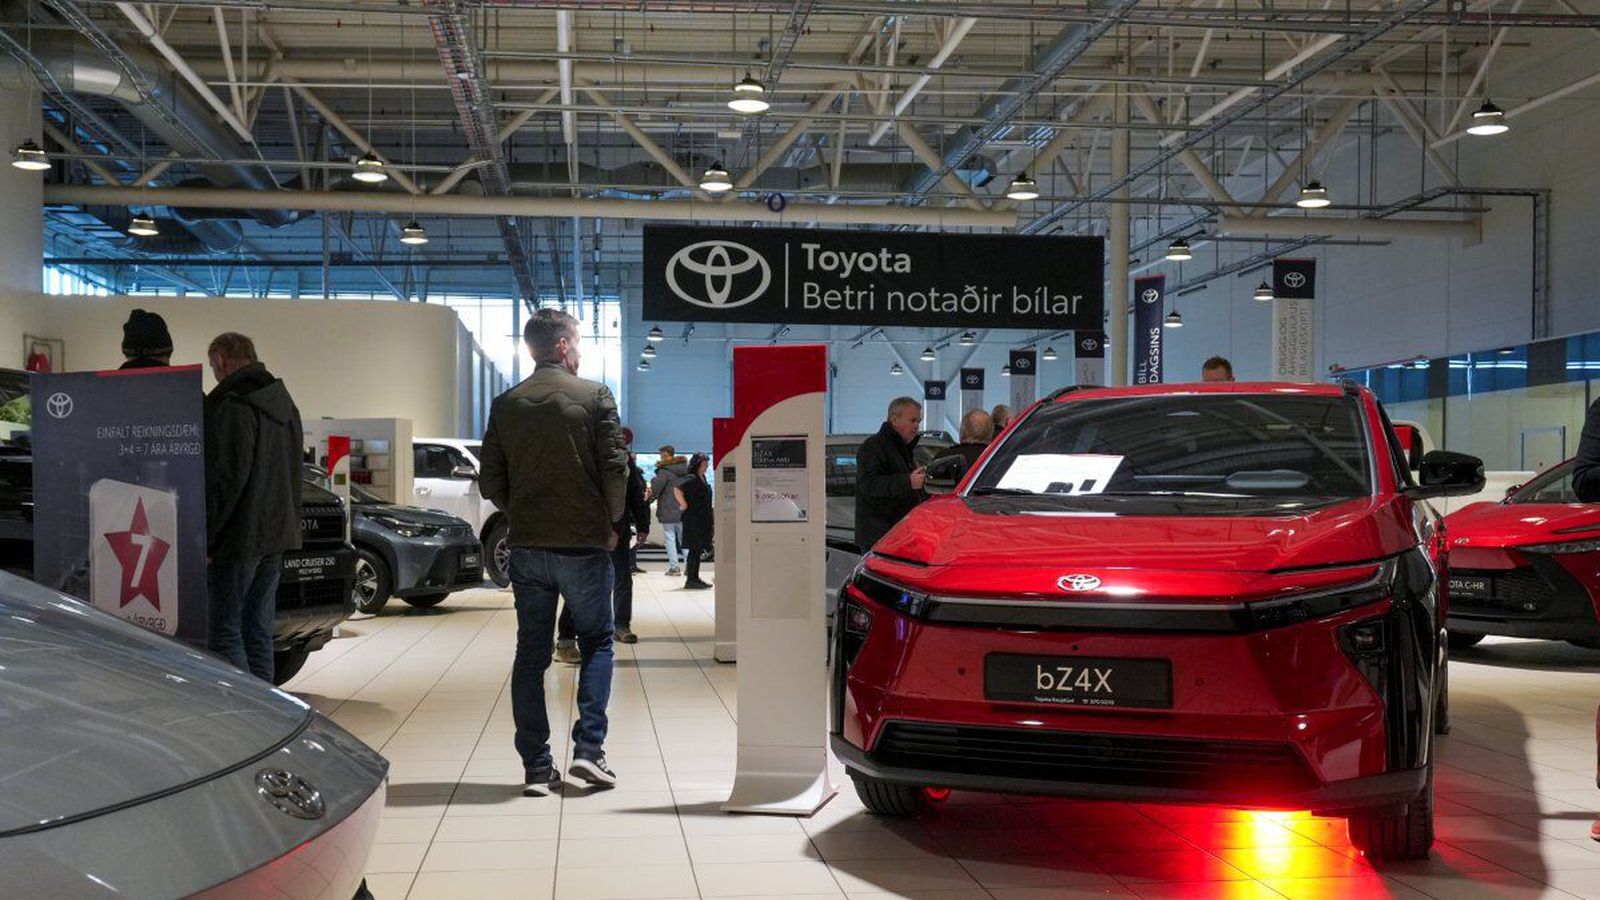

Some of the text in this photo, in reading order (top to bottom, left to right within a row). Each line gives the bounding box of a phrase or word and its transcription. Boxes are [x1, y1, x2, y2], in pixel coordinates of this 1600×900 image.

[801, 243, 912, 279] Toyota
[803, 282, 1083, 315] Betri notaðir bílar
[1149, 327, 1160, 383] DAGSINS
[301, 519, 319, 530] OTA
[130, 533, 152, 588] 7
[284, 559, 301, 569] LAND
[301, 557, 324, 567] CRUISER
[1449, 580, 1485, 590] OTA C-HR
[1037, 664, 1113, 693] bZ4X
